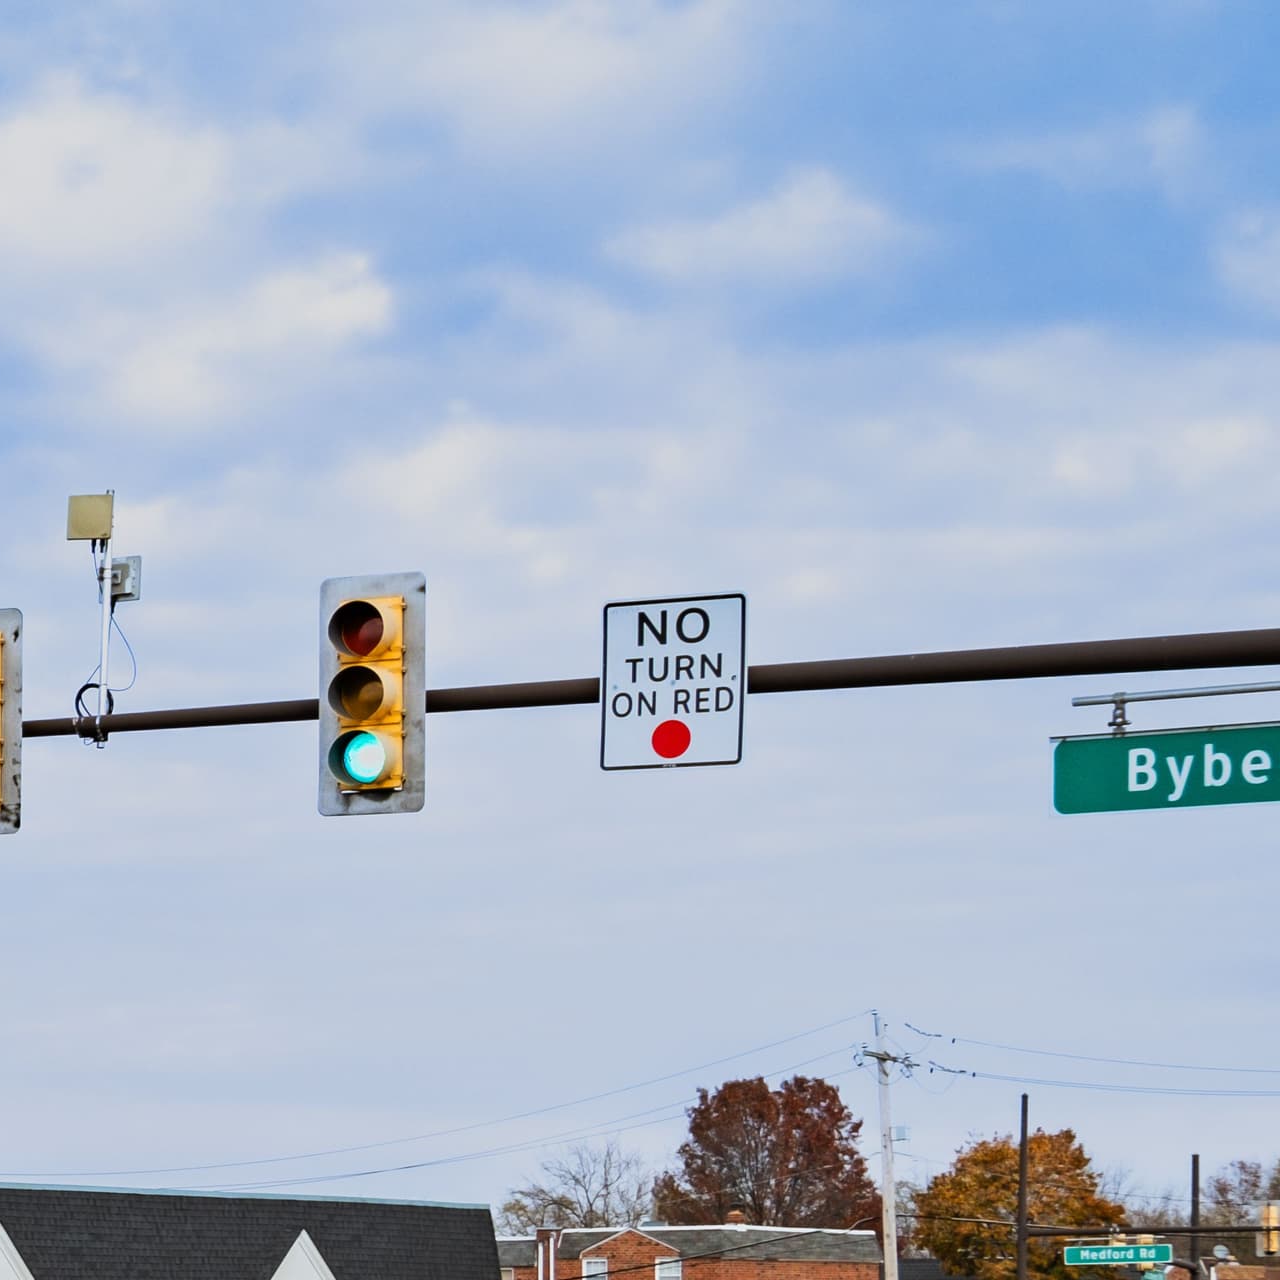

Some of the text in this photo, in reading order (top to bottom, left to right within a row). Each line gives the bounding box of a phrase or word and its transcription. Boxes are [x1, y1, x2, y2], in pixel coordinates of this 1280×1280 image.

[637, 607, 711, 647] NO
[624, 652, 724, 684] TURN
[611, 686, 735, 718] ON RED
[1127, 743, 1272, 802] Bybe
[1080, 1247, 1156, 1260] Medford Rd
